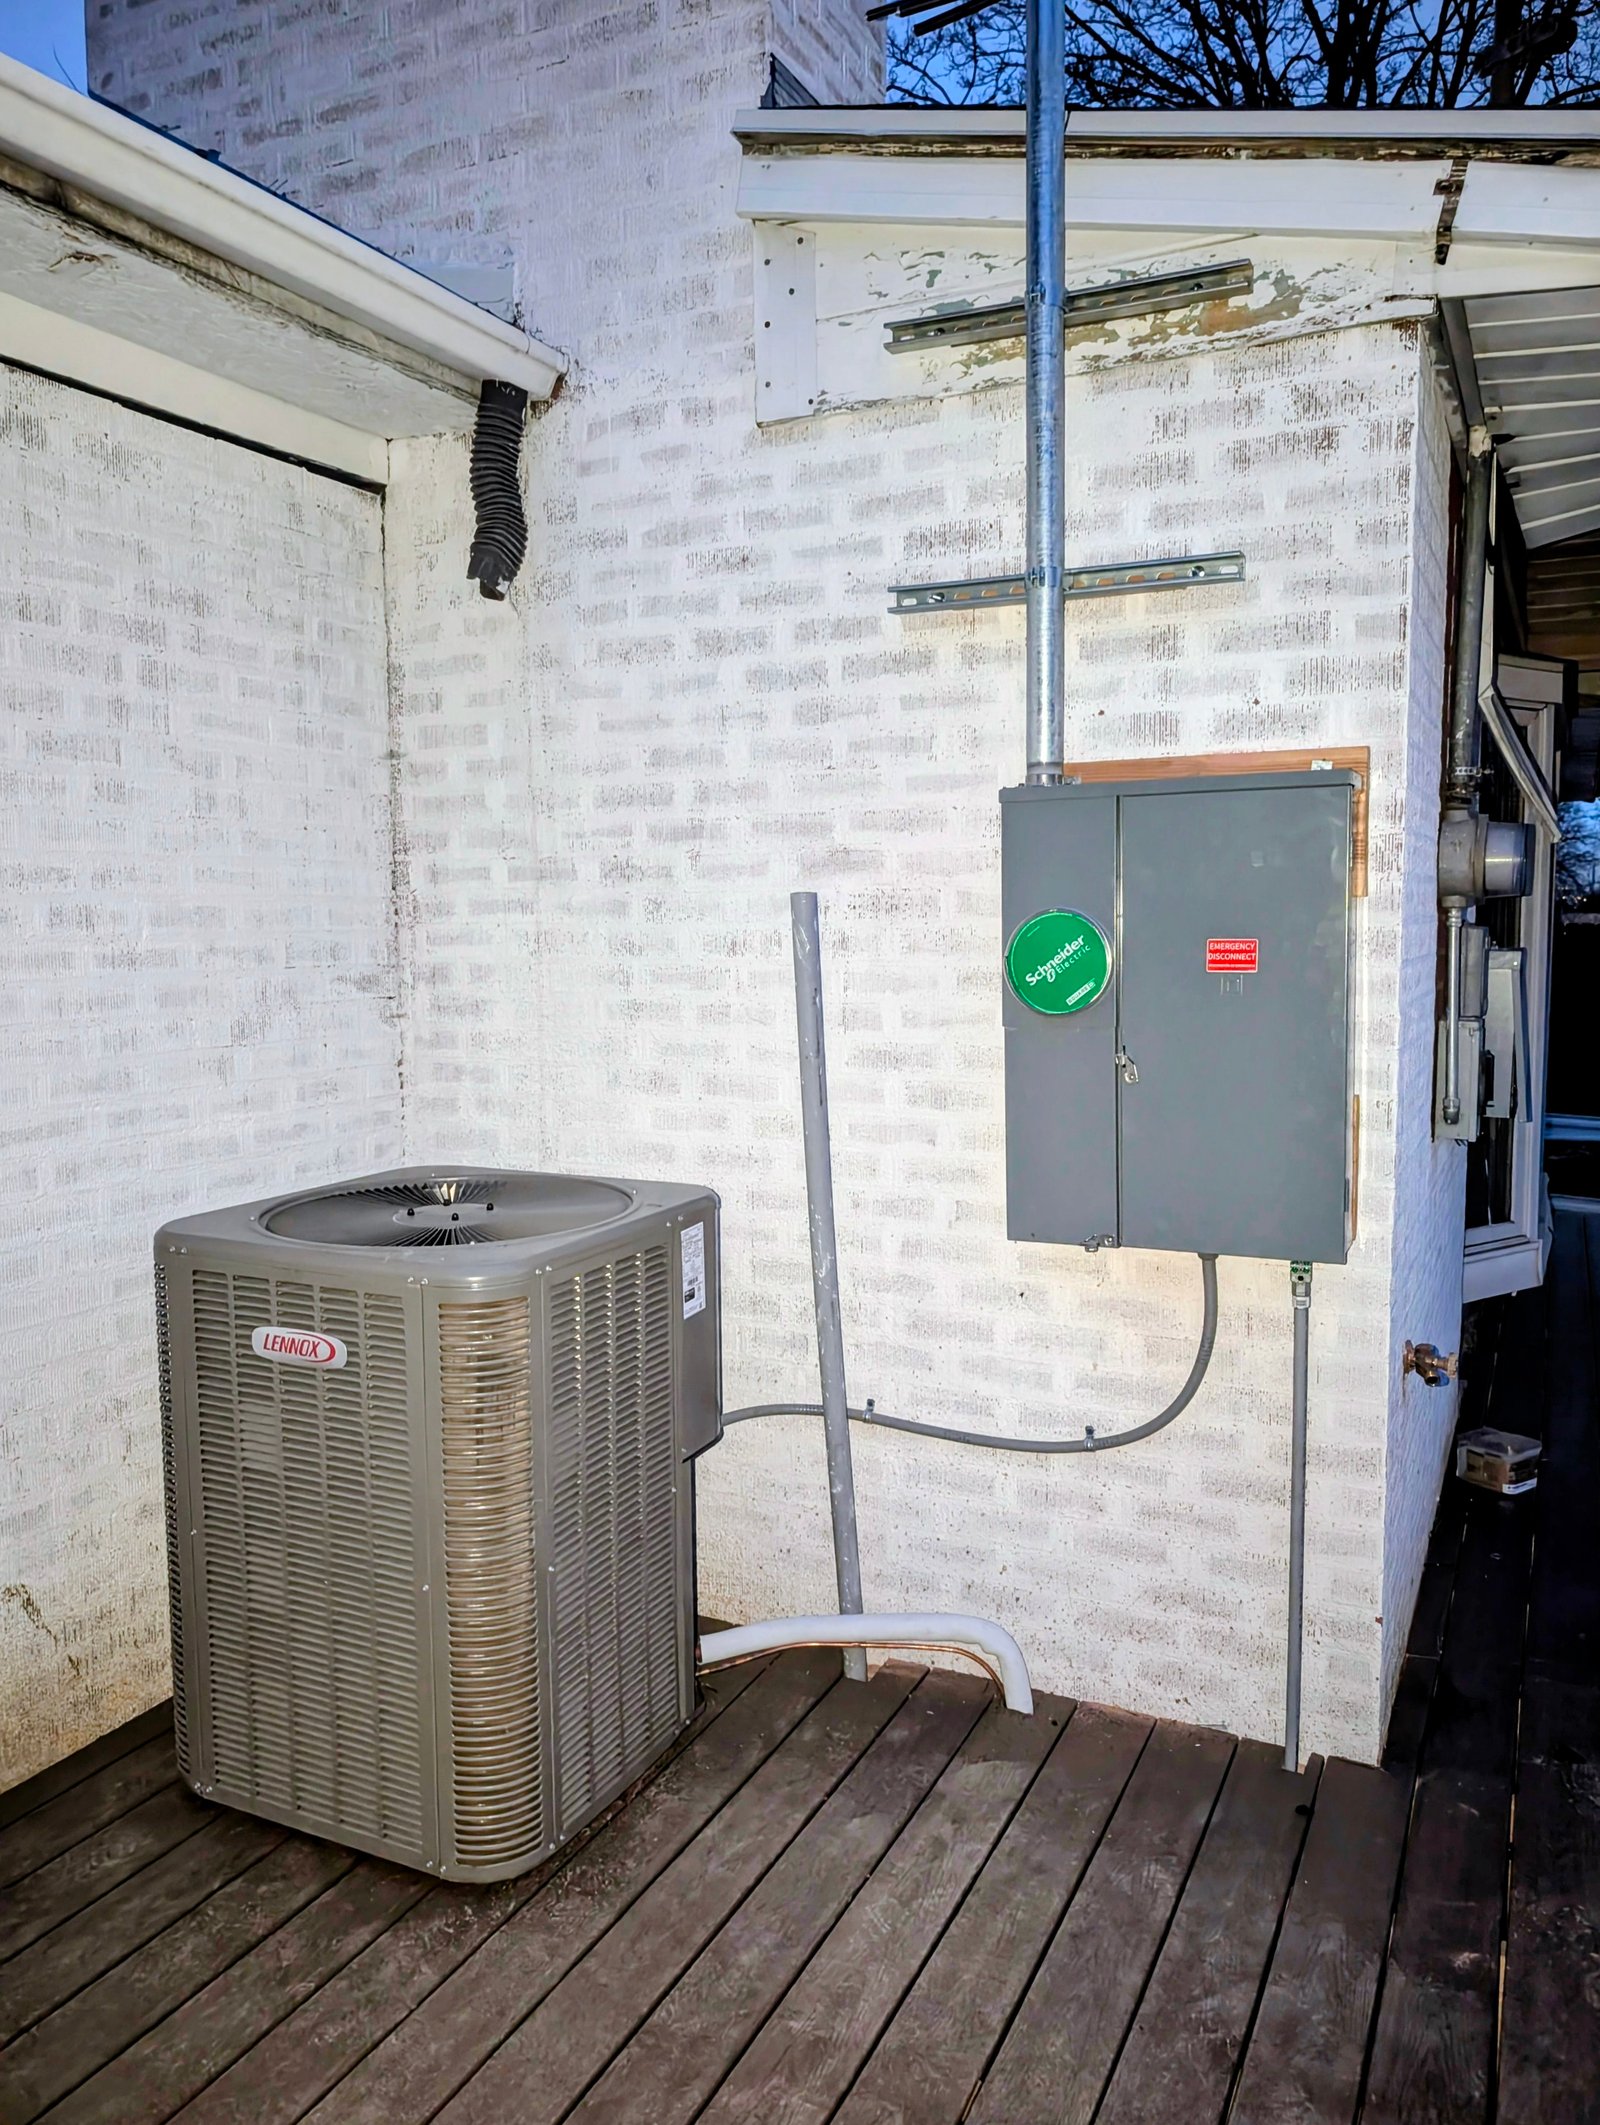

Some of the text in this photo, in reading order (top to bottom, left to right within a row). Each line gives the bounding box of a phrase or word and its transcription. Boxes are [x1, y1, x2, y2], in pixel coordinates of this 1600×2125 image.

[1055, 944, 1091, 973] Electric
[1207, 952, 1256, 961] DISCONNECT
[1209, 942, 1256, 951] EMERGENCY
[1025, 934, 1084, 986] Schneider
[263, 1333, 320, 1358] LENNOX
